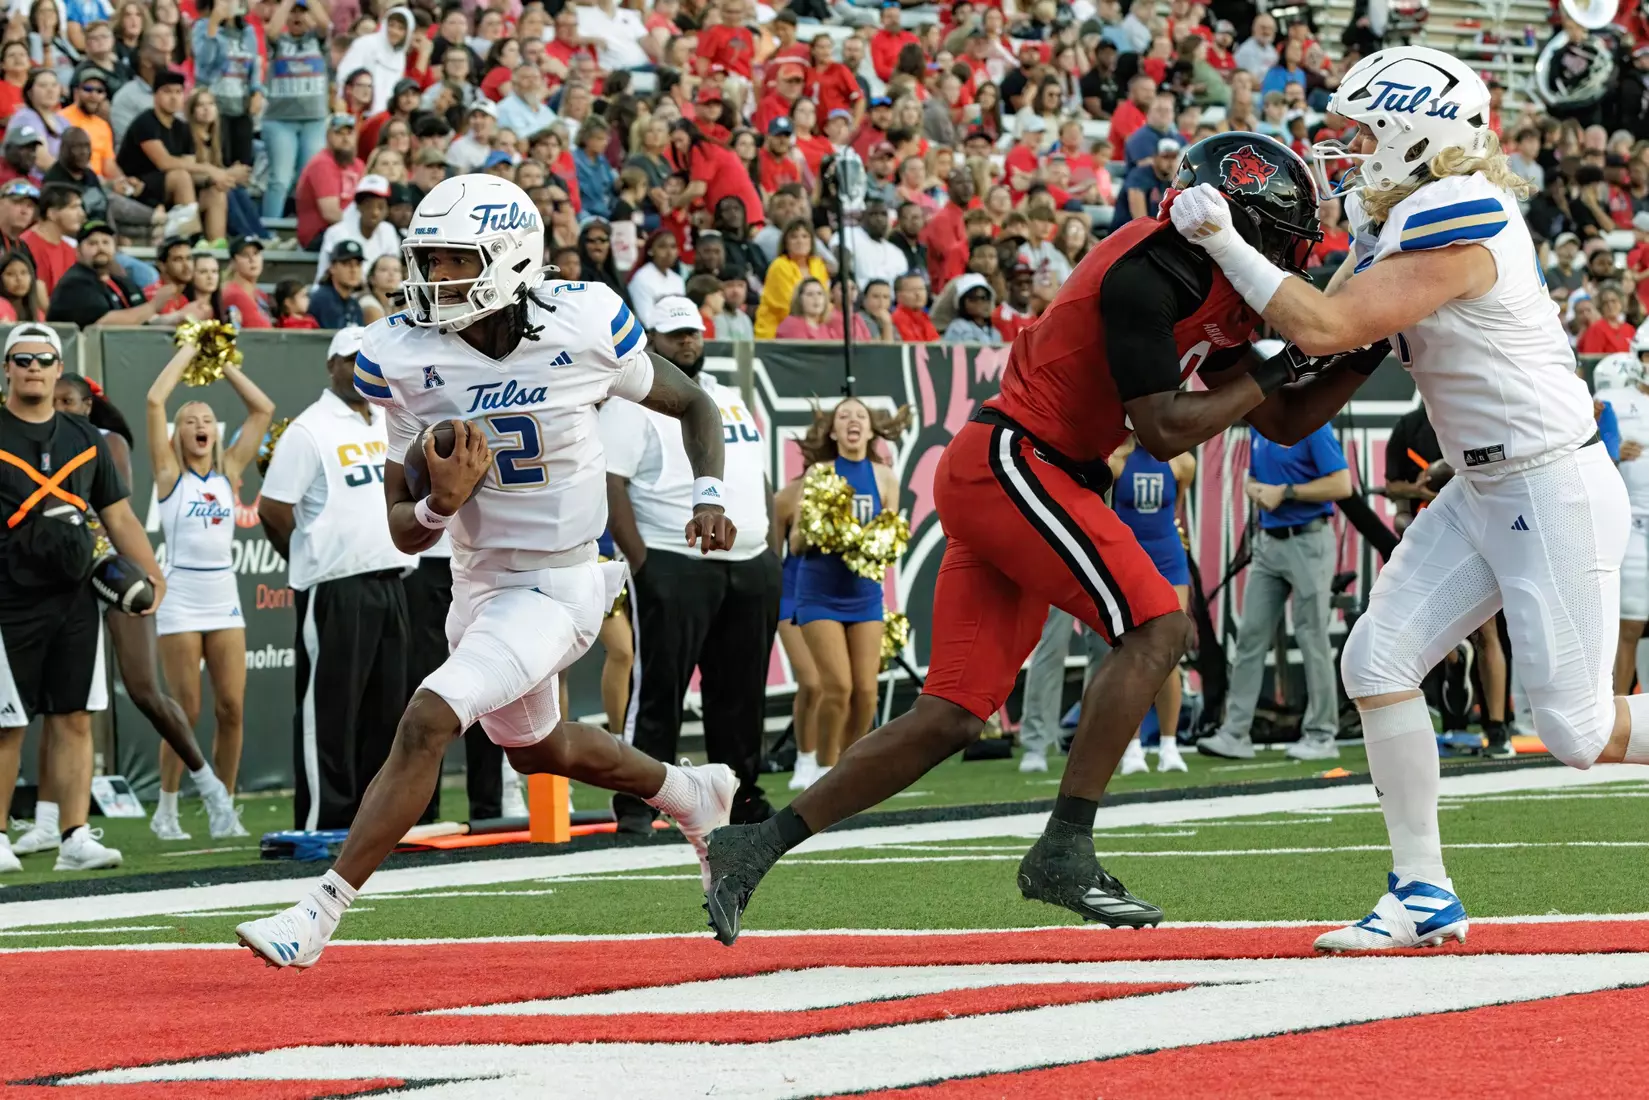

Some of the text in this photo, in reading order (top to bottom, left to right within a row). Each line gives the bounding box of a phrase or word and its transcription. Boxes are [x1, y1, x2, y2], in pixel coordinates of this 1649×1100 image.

[1366, 81, 1461, 120] Tulsa
[415, 227, 438, 235] TULSA
[473, 202, 537, 235] Tulsa
[467, 380, 548, 412] Tulsa
[484, 412, 549, 489] 2
[186, 501, 230, 517] Tulsa
